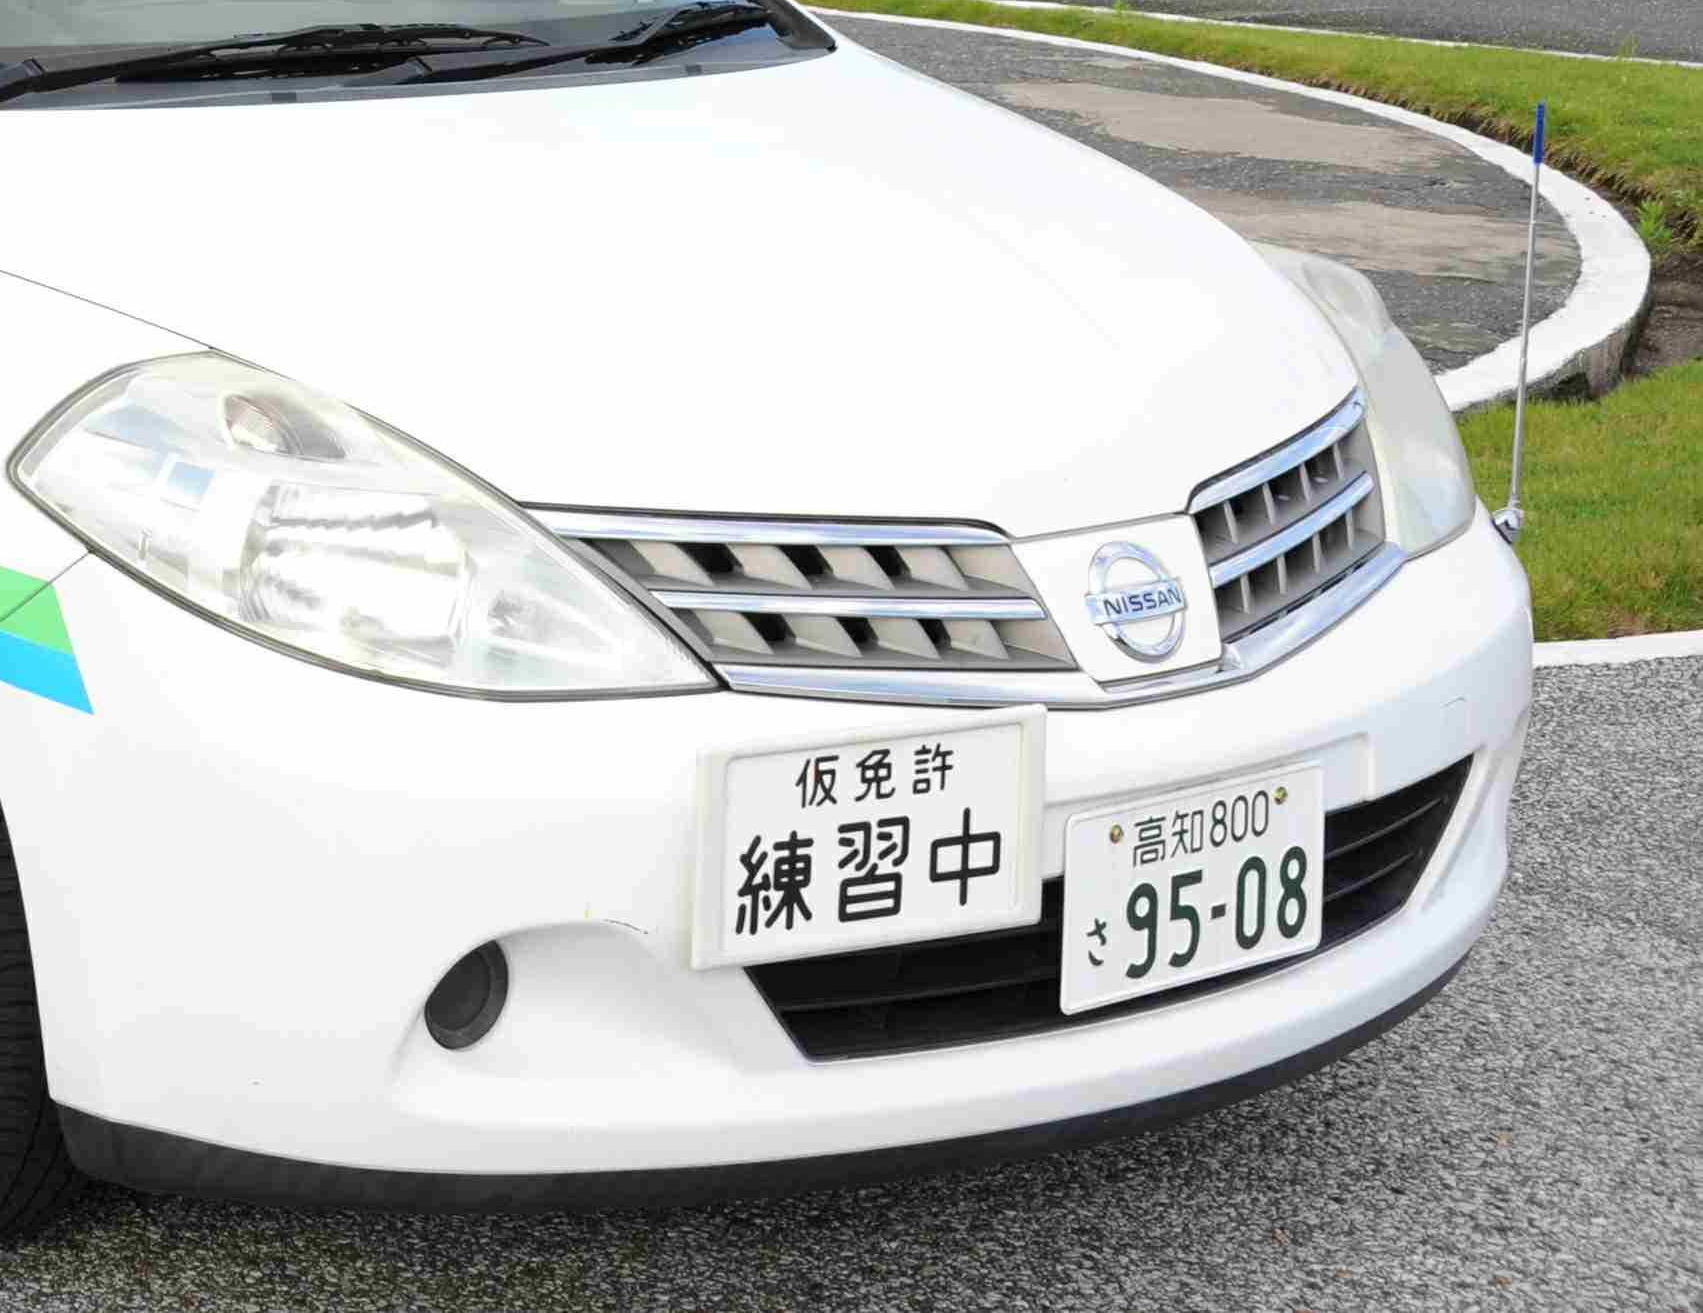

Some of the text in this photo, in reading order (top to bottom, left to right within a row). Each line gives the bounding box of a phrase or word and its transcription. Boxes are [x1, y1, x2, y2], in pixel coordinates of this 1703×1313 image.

[1102, 588, 1182, 617] NISSAN
[795, 742, 955, 809] 仮免許
[1132, 789, 1271, 868] 高知800
[735, 806, 1002, 936] 練習中
[1085, 845, 1307, 980] さ 95-08
